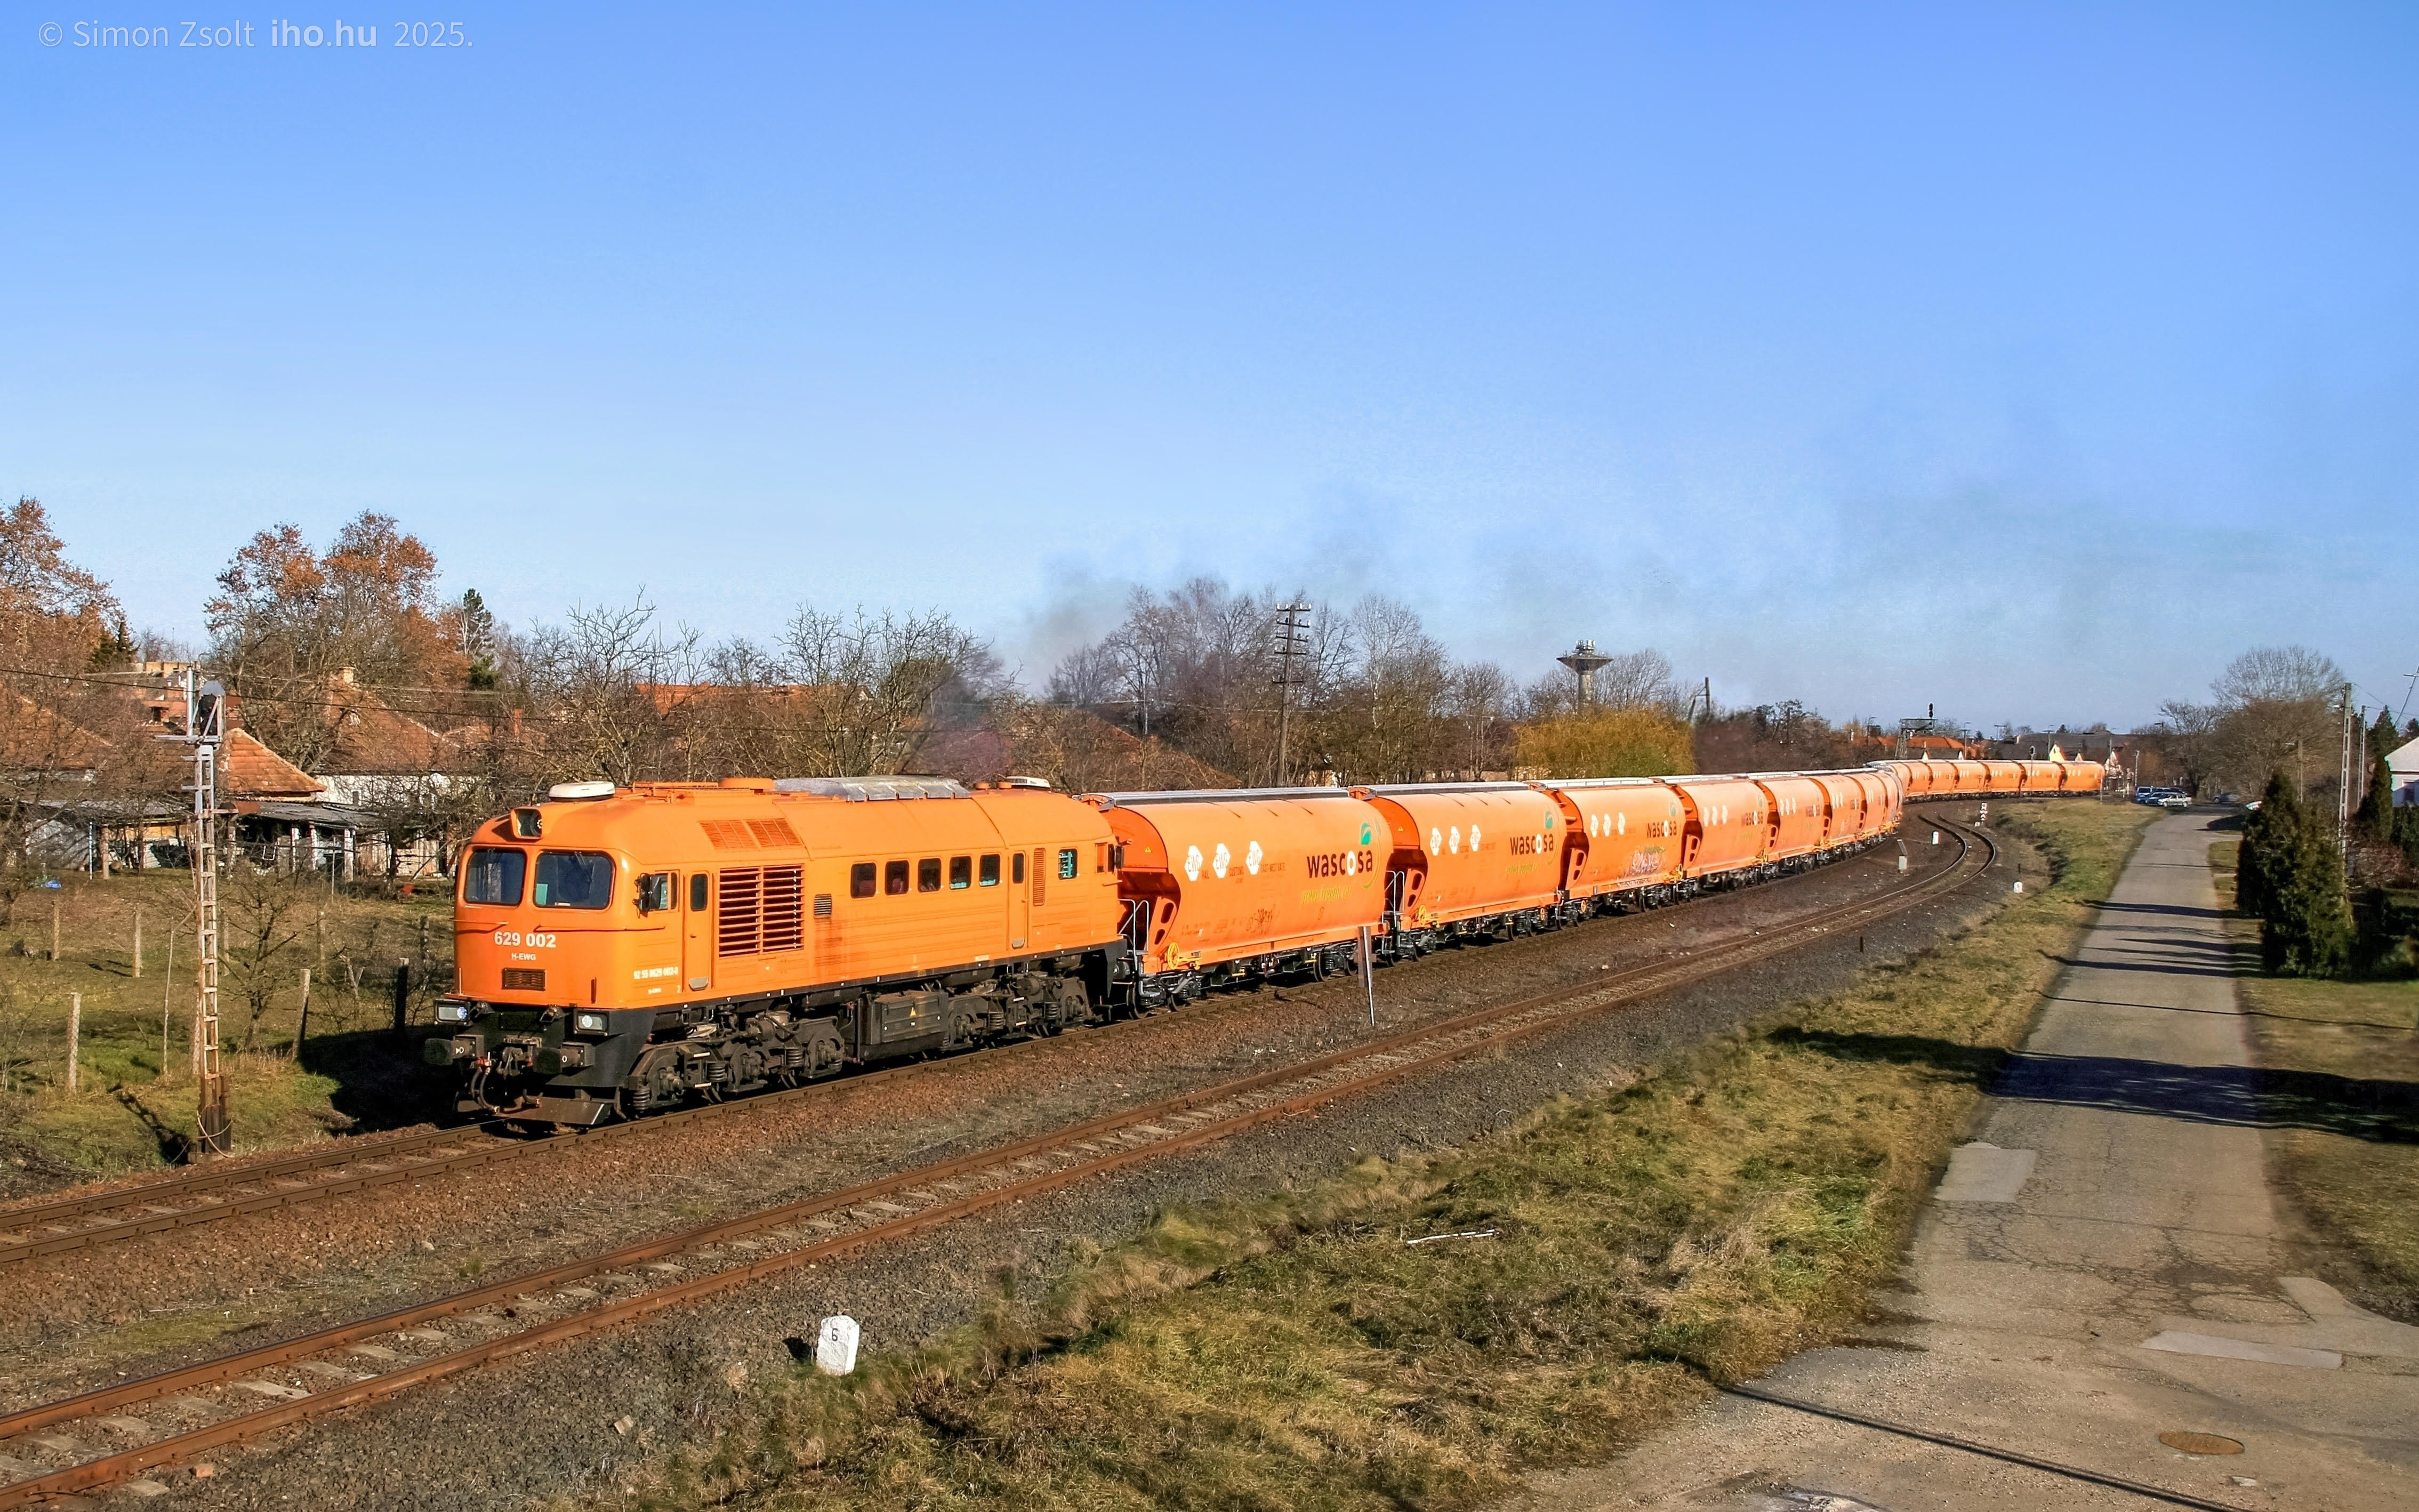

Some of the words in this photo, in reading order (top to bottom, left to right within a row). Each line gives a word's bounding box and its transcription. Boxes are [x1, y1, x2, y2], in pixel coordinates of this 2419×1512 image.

[1510, 833, 1554, 856] wascosa
[1188, 854, 1200, 872] EWG
[1216, 852, 1227, 870] EWG
[1249, 849, 1260, 866] EWG
[1307, 850, 1373, 878] wascosa
[494, 931, 521, 946] 629
[526, 933, 556, 948] 002
[511, 952, 536, 961] H-EWG
[831, 1328, 839, 1342] 6
